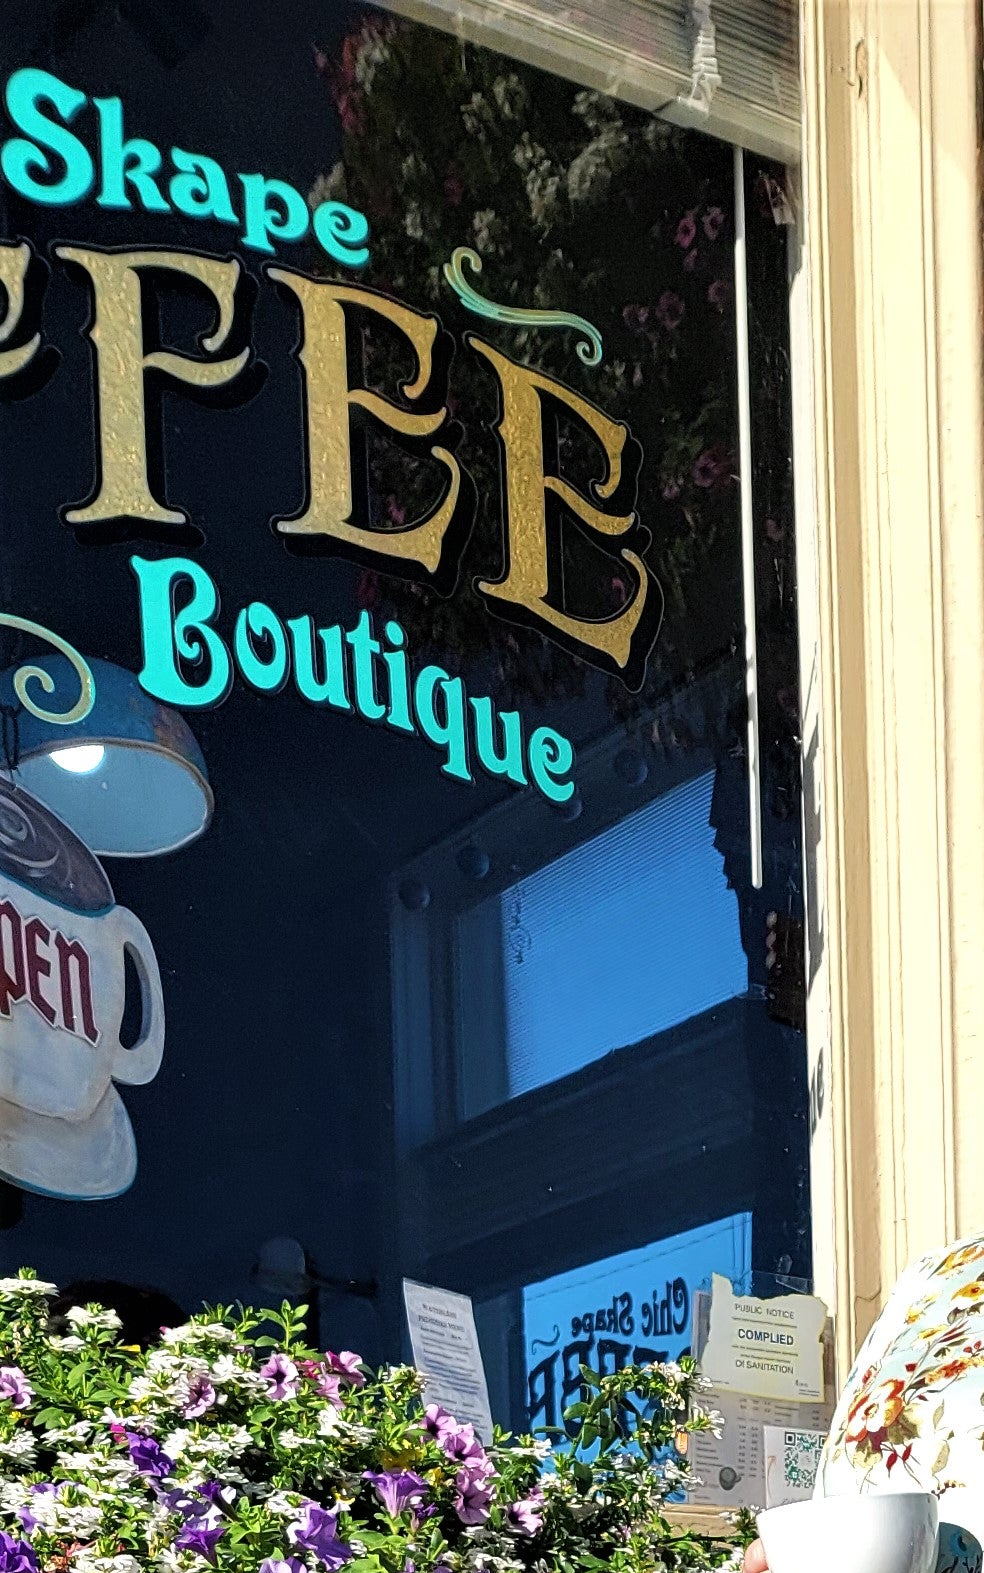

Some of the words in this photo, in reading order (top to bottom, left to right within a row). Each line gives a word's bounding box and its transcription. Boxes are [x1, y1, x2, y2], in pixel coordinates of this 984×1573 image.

[2, 68, 370, 267] Skape
[131, 555, 575, 802] Boutique
[734, 1302, 763, 1315] PUBLIC
[766, 1308, 795, 1320] NOTICE
[738, 1328, 794, 1346] COMPLIED
[746, 1360, 794, 1375] SANITATION
